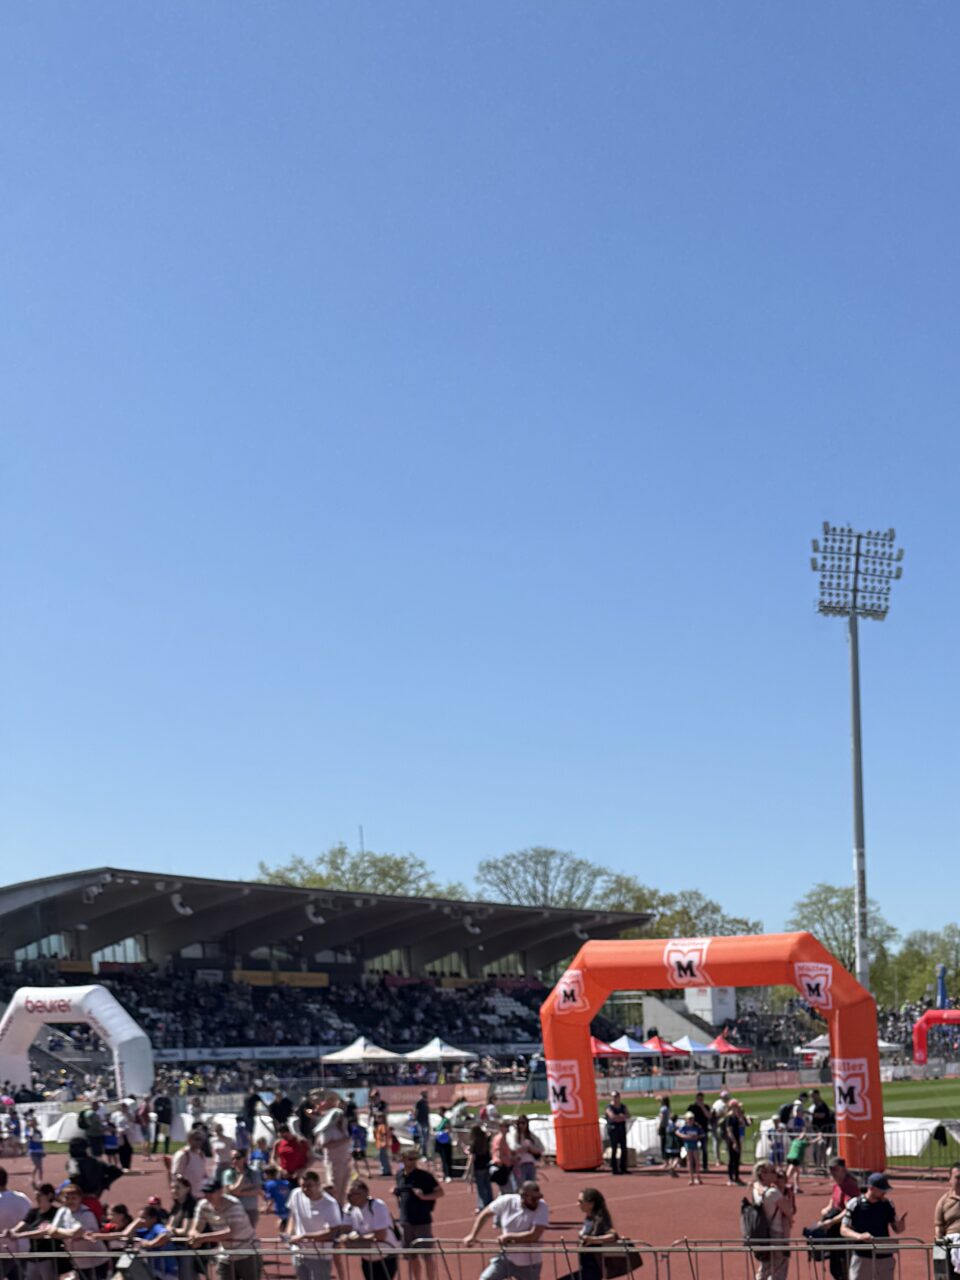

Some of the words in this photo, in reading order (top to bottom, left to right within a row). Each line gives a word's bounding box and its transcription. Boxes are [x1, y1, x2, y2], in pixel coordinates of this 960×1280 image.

[676, 960, 697, 978] M
[563, 989, 577, 1003] M
[806, 982, 821, 997] M
[25, 996, 72, 1013] beurer
[552, 1085, 569, 1103] M
[838, 1085, 857, 1105] M
